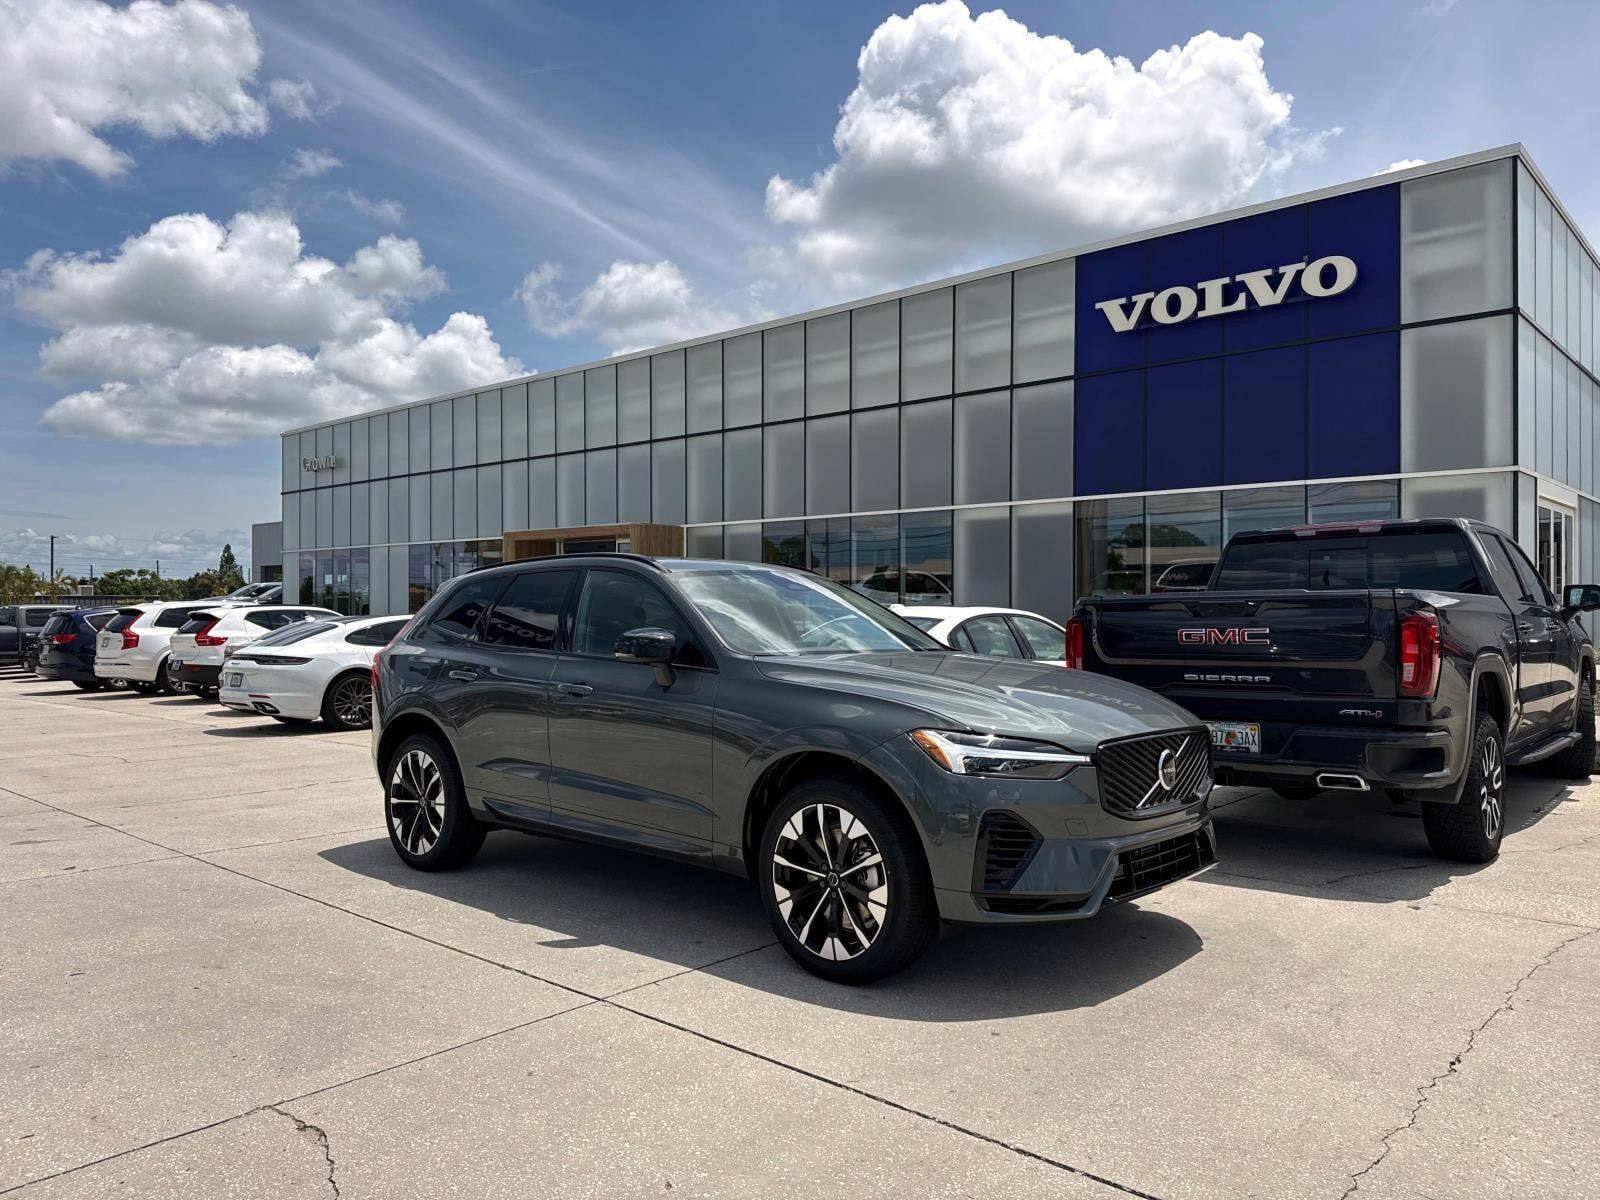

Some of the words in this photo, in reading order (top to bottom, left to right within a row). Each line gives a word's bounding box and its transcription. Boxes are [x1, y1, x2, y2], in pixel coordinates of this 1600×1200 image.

[1094, 255, 1358, 333] VOLVO
[1177, 627, 1270, 645] GMC
[1183, 673, 1271, 683] SIERRA
